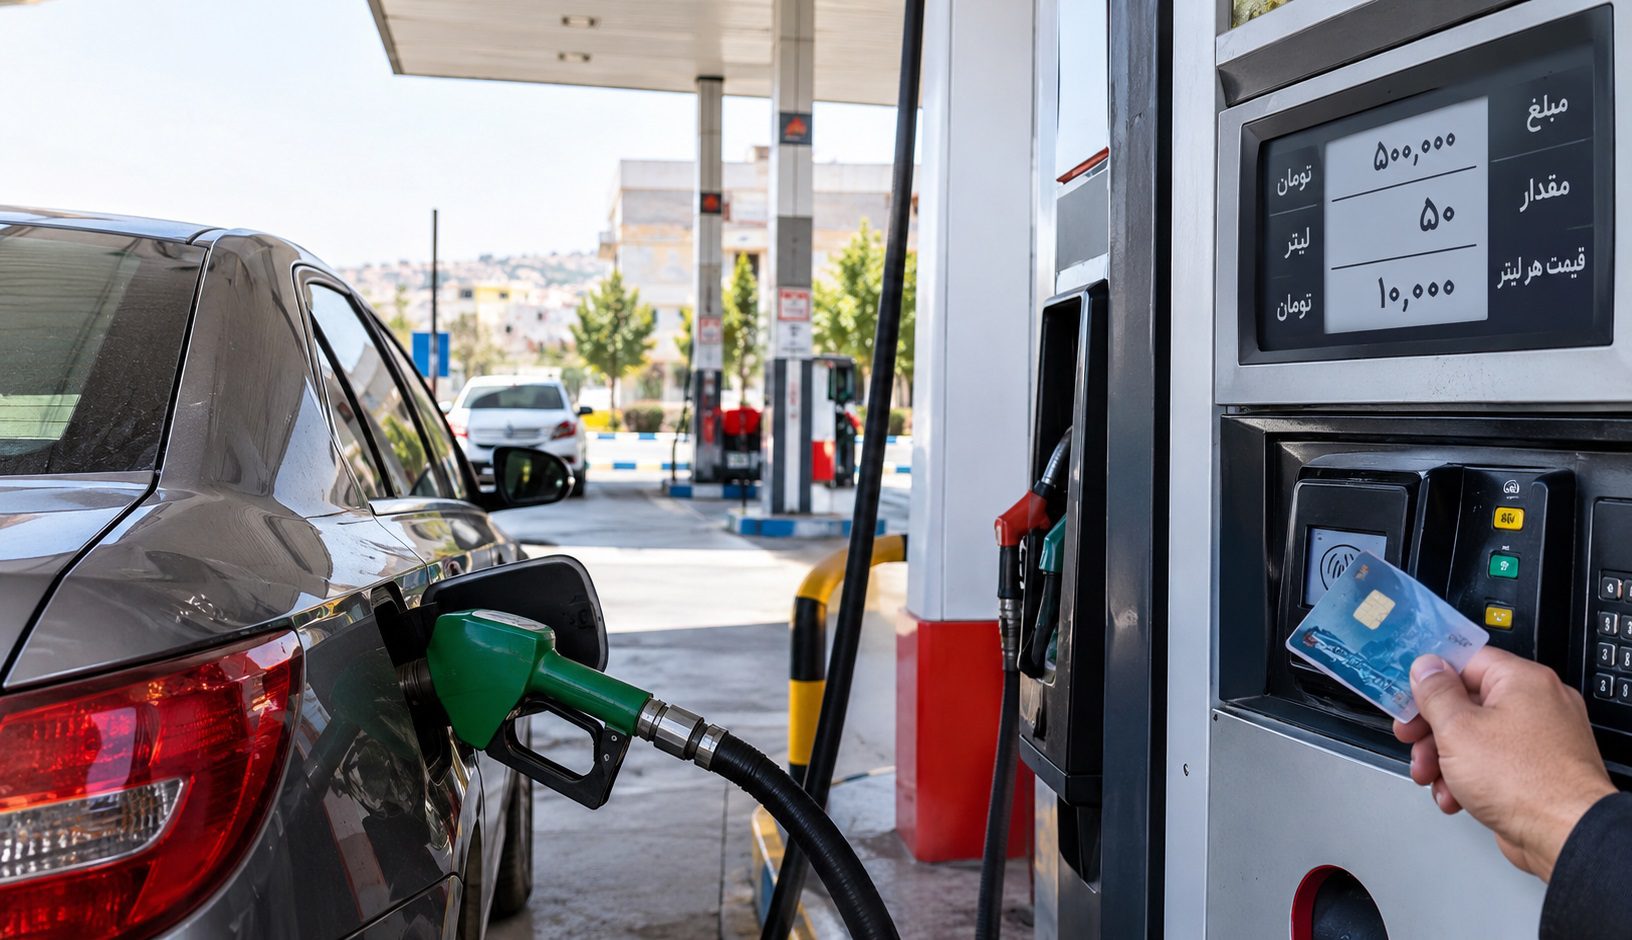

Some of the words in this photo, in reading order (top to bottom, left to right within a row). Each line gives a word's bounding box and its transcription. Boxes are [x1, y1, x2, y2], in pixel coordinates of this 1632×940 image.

[1527, 95, 1568, 132] مبلغ
[1277, 166, 1312, 196] تومان
[1520, 175, 1570, 212] مقدار
[1420, 197, 1455, 232] ۵۰
[1284, 227, 1310, 259] لیتر
[1497, 256, 1522, 289] لیتر
[1524, 259, 1543, 286] هر
[1547, 247, 1586, 281] قیمت
[1277, 294, 1312, 321] تومان
